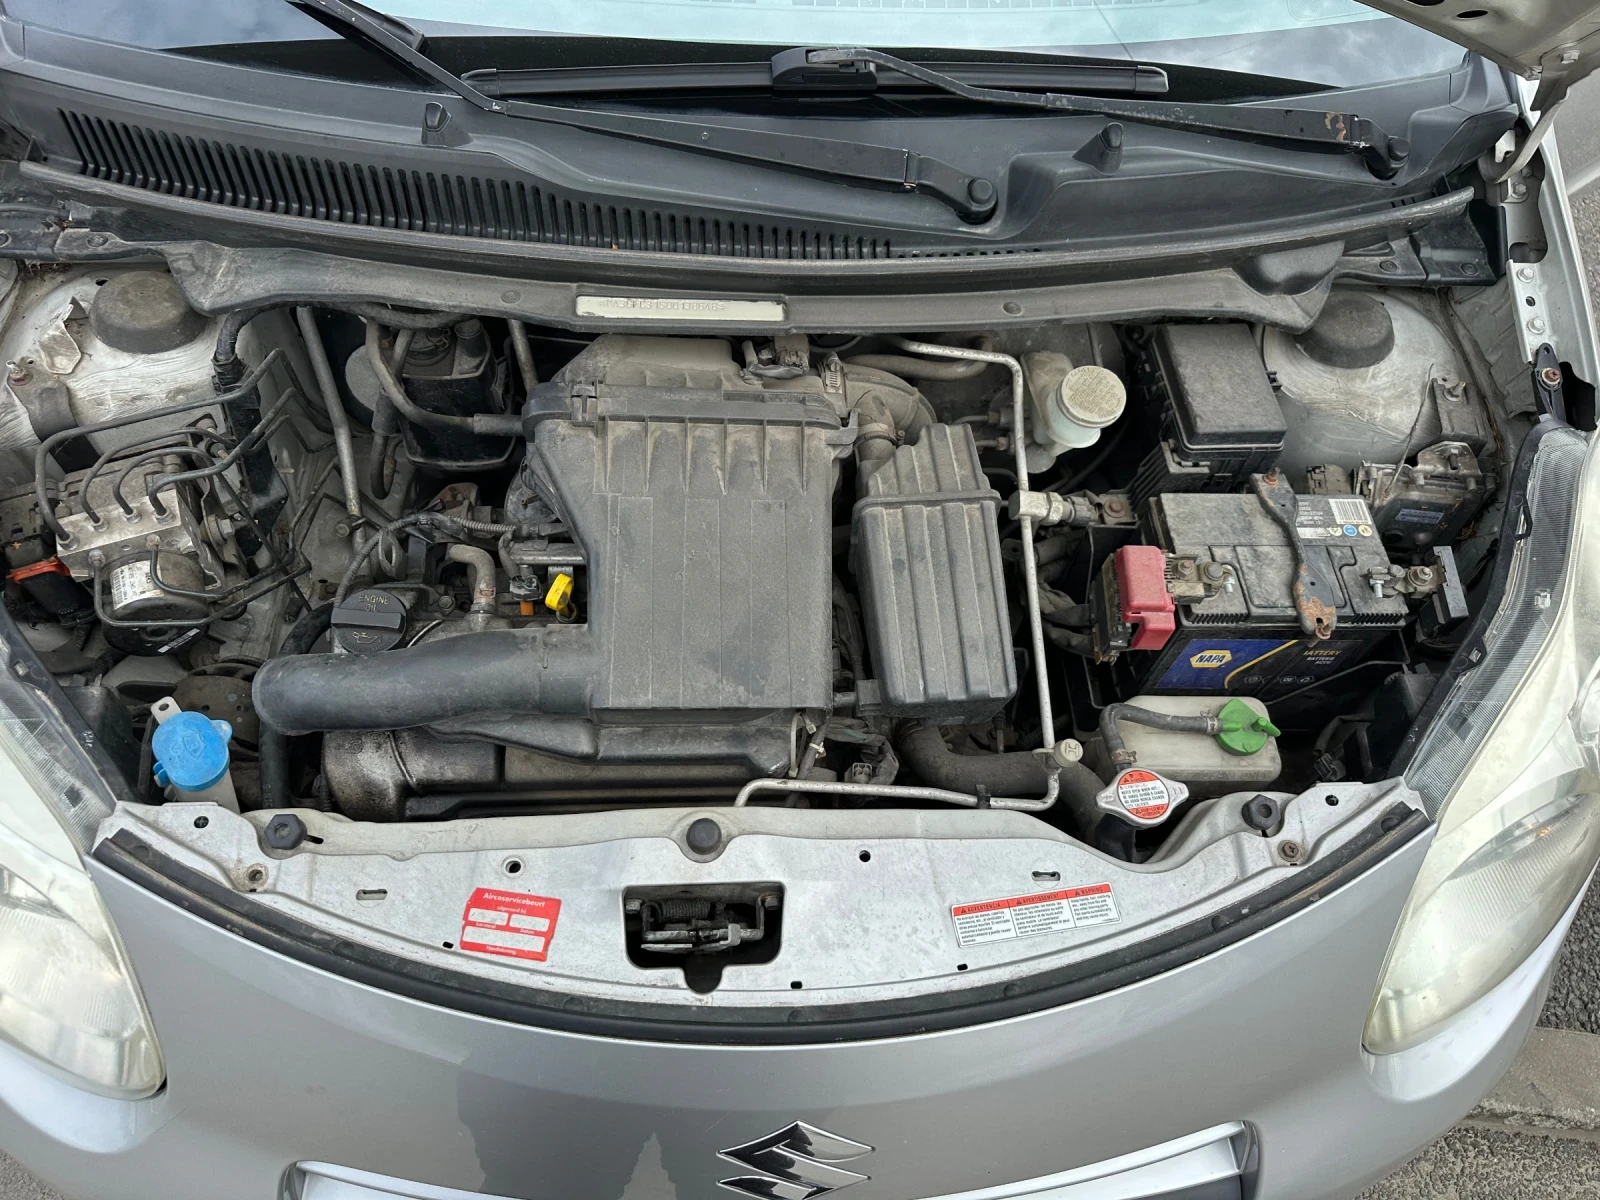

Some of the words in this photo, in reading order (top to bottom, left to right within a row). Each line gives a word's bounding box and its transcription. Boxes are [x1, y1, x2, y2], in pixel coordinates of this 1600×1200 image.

[359, 594, 389, 605] ENGINE
[365, 603, 376, 612] OIL
[1195, 654, 1227, 664] NAPA
[1065, 741, 1080, 758] H
[483, 892, 546, 907] Aircoservicebeurt
[1023, 894, 1059, 903] AVERTISSEMENT
[967, 902, 1001, 913] ADVERTENCIA
